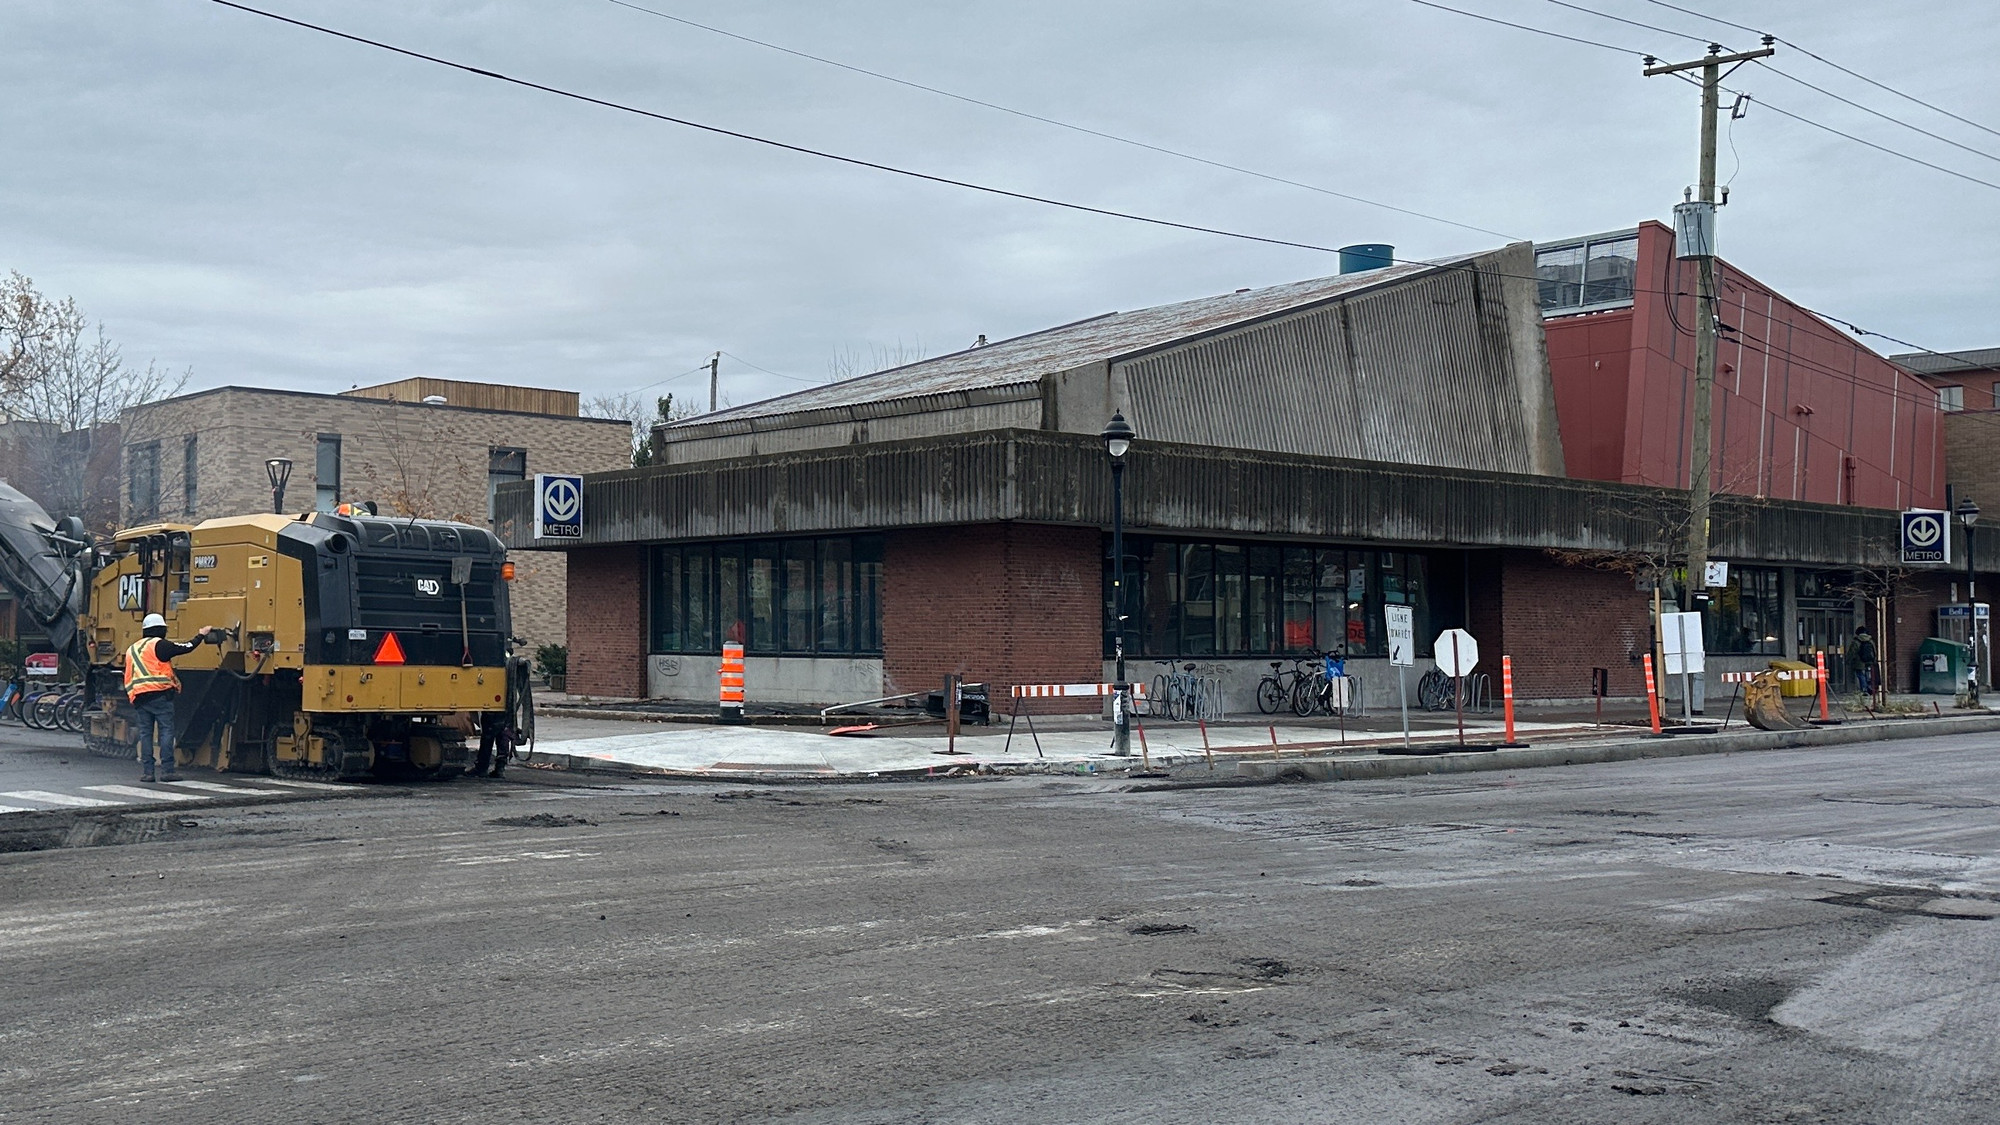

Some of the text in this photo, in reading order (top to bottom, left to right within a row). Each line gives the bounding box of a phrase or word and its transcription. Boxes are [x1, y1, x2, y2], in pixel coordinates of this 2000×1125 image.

[544, 523, 580, 536] METRO
[1905, 550, 1942, 560] METRO
[119, 574, 145, 610] CAT
[417, 579, 439, 595] CAT
[1949, 607, 1963, 616] Bell
[1391, 613, 1408, 624] LIGNE
